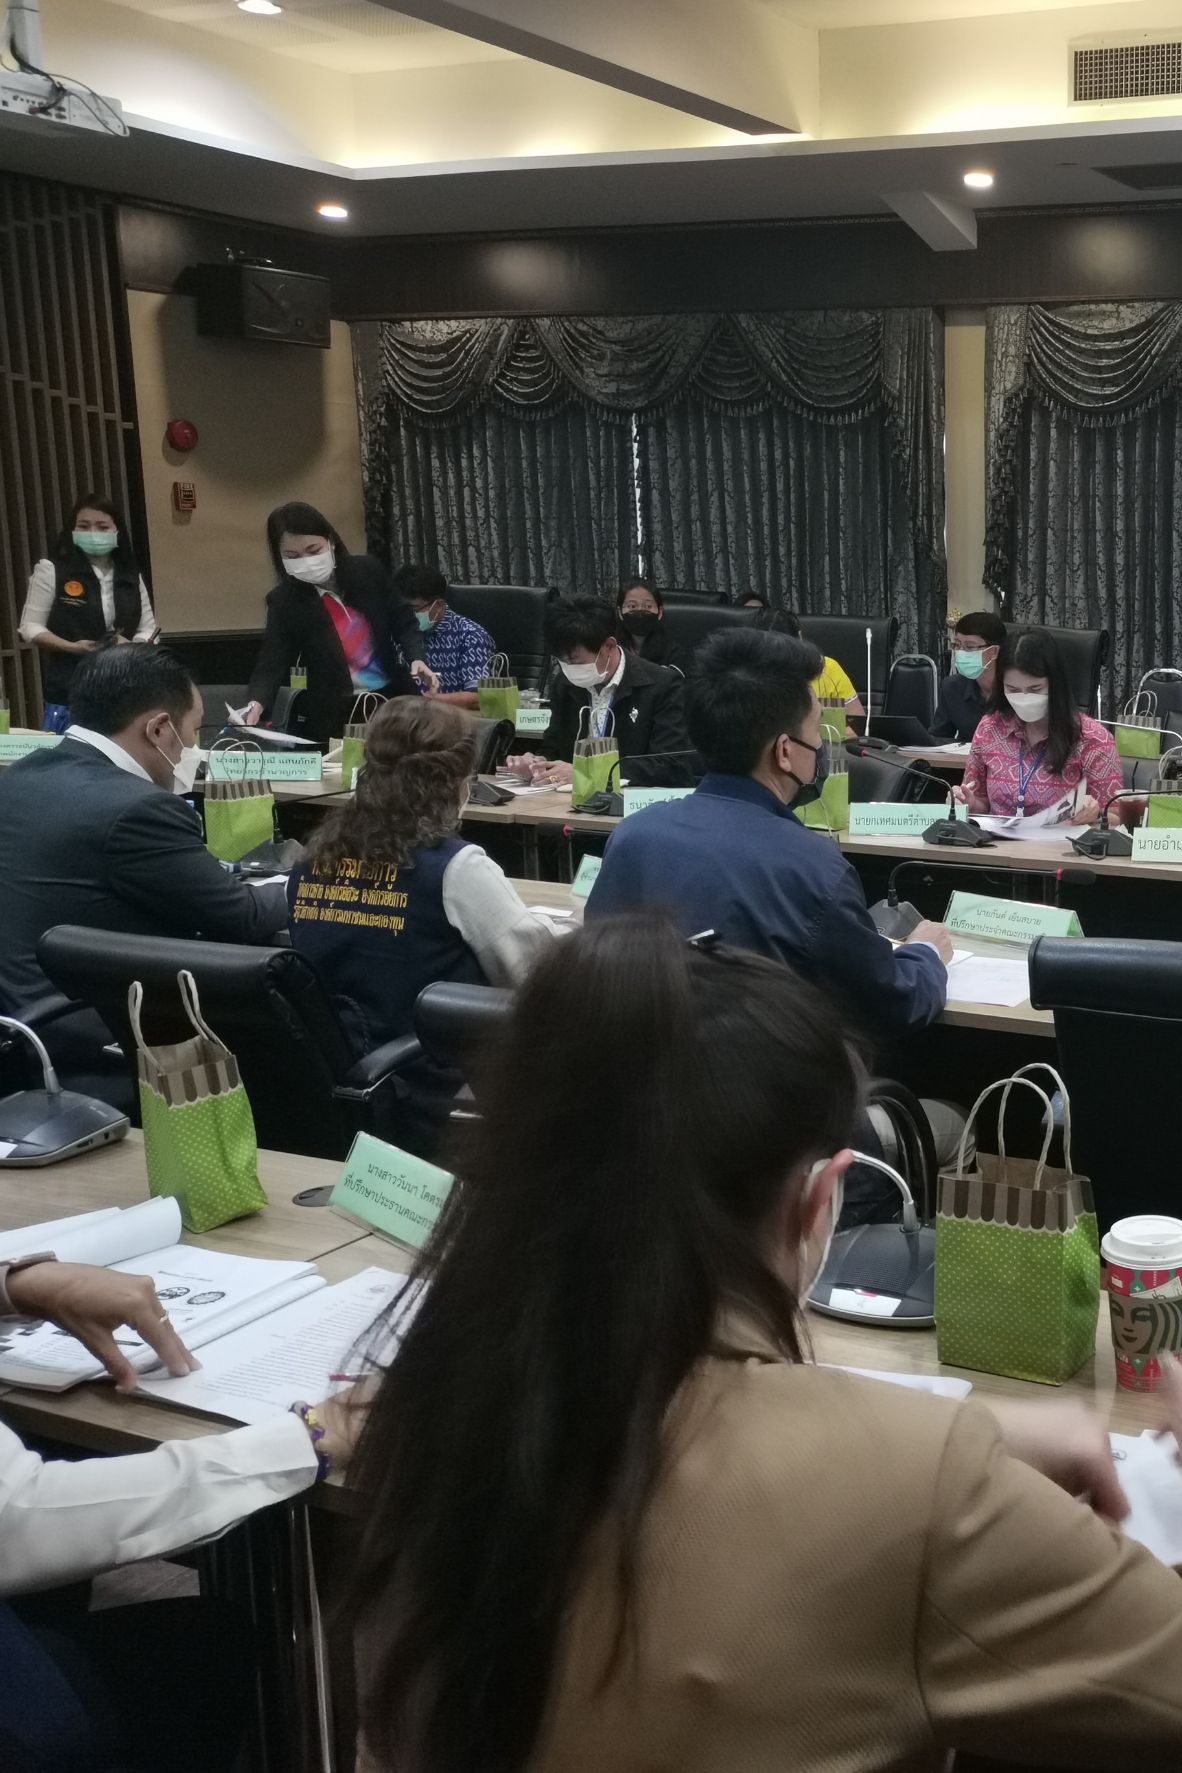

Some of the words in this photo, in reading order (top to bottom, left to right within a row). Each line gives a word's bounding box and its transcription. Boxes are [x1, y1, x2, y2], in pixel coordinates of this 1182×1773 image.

[855, 814, 937, 826] นายกเทศมนตรีตำบล
